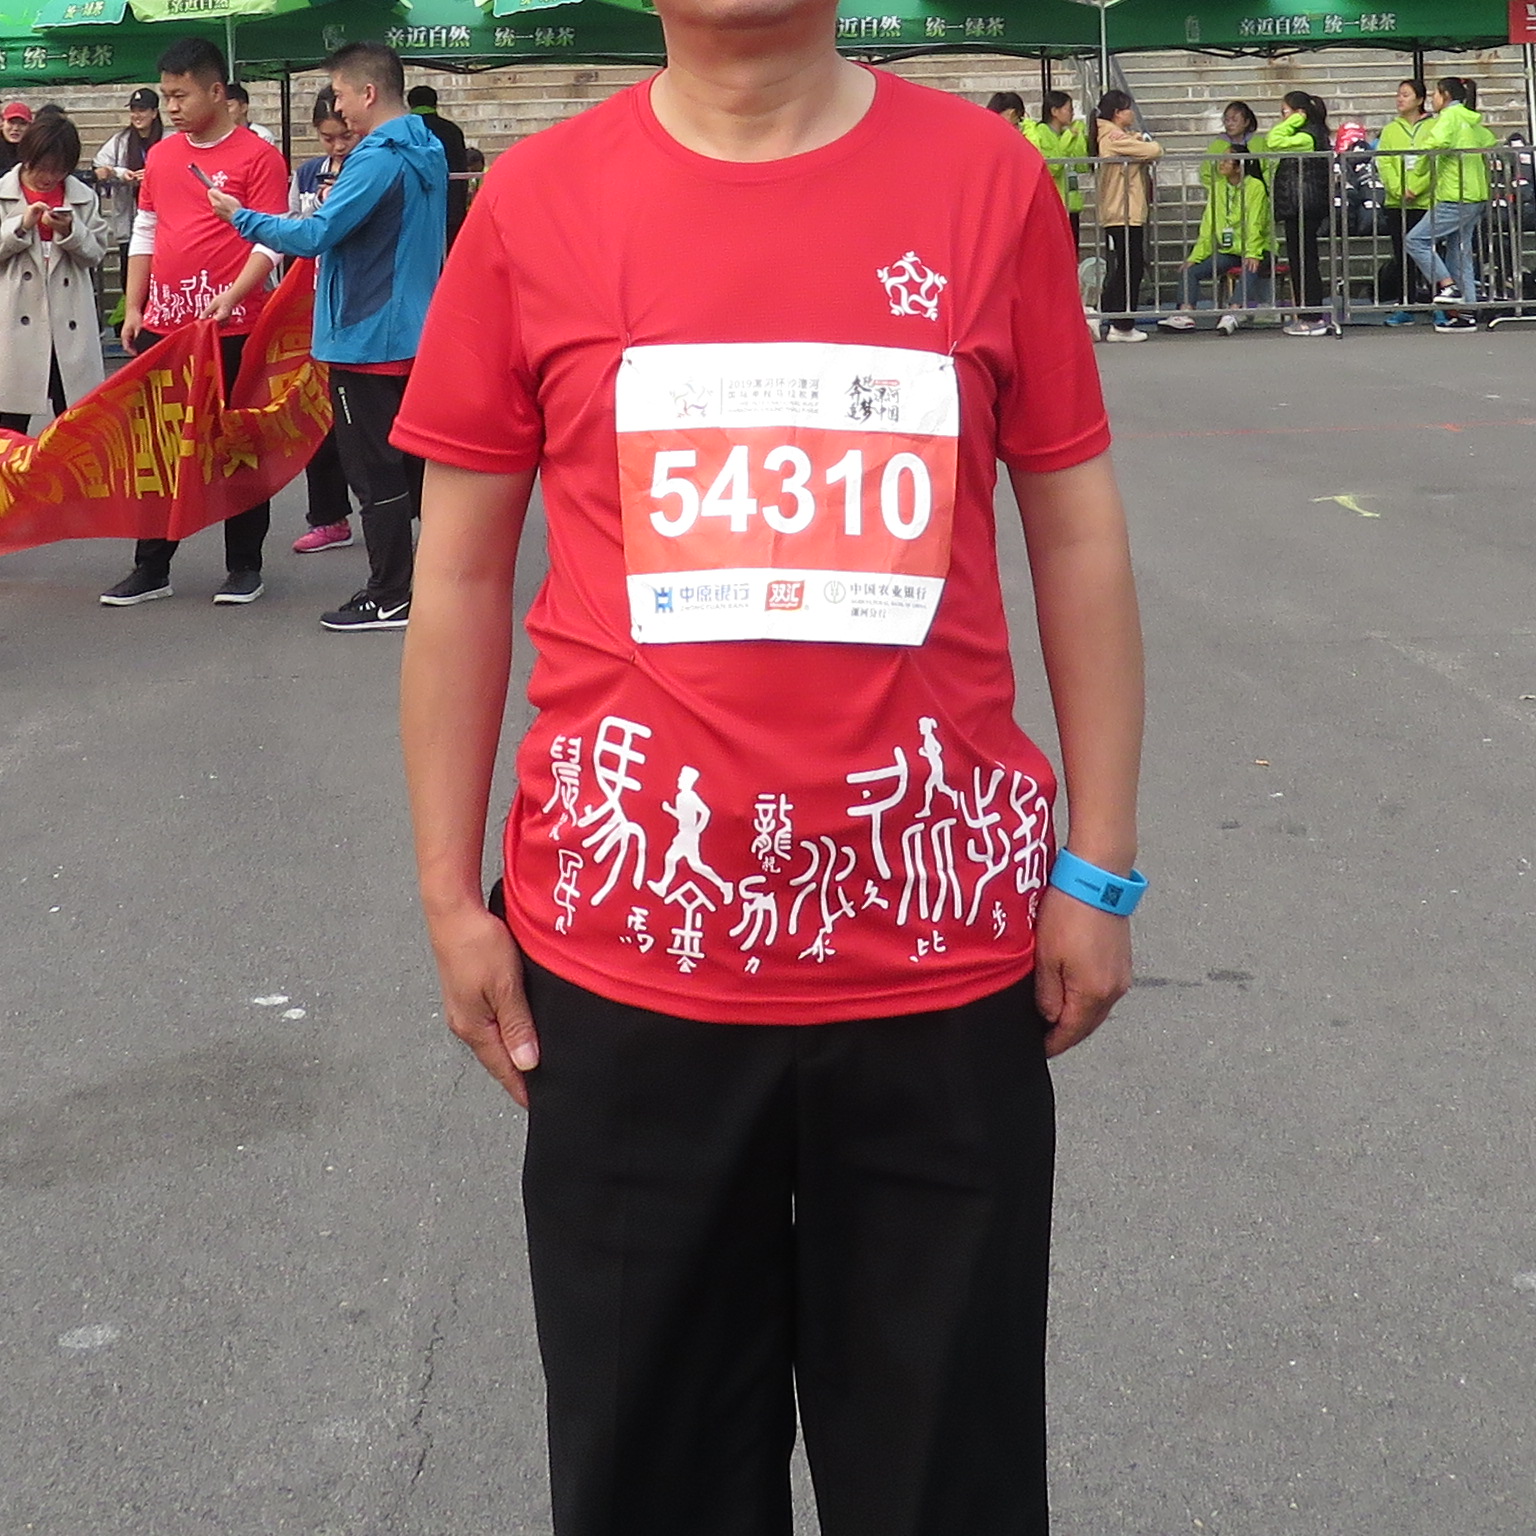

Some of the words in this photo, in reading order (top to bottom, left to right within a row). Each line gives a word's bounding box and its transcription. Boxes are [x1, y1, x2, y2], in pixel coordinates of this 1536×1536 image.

[837, 16, 902, 38] 近自然
[925, 16, 1005, 38] 统一绿茶
[1323, 13, 1397, 33] 统一绿茶
[494, 25, 576, 47] 统一绿茶
[24, 45, 112, 70] 统一绿茶
[649, 445, 932, 540] 54310
[679, 583, 749, 603] 中原银行
[769, 583, 800, 602] 双汇
[850, 583, 927, 601] 中国农业银行
